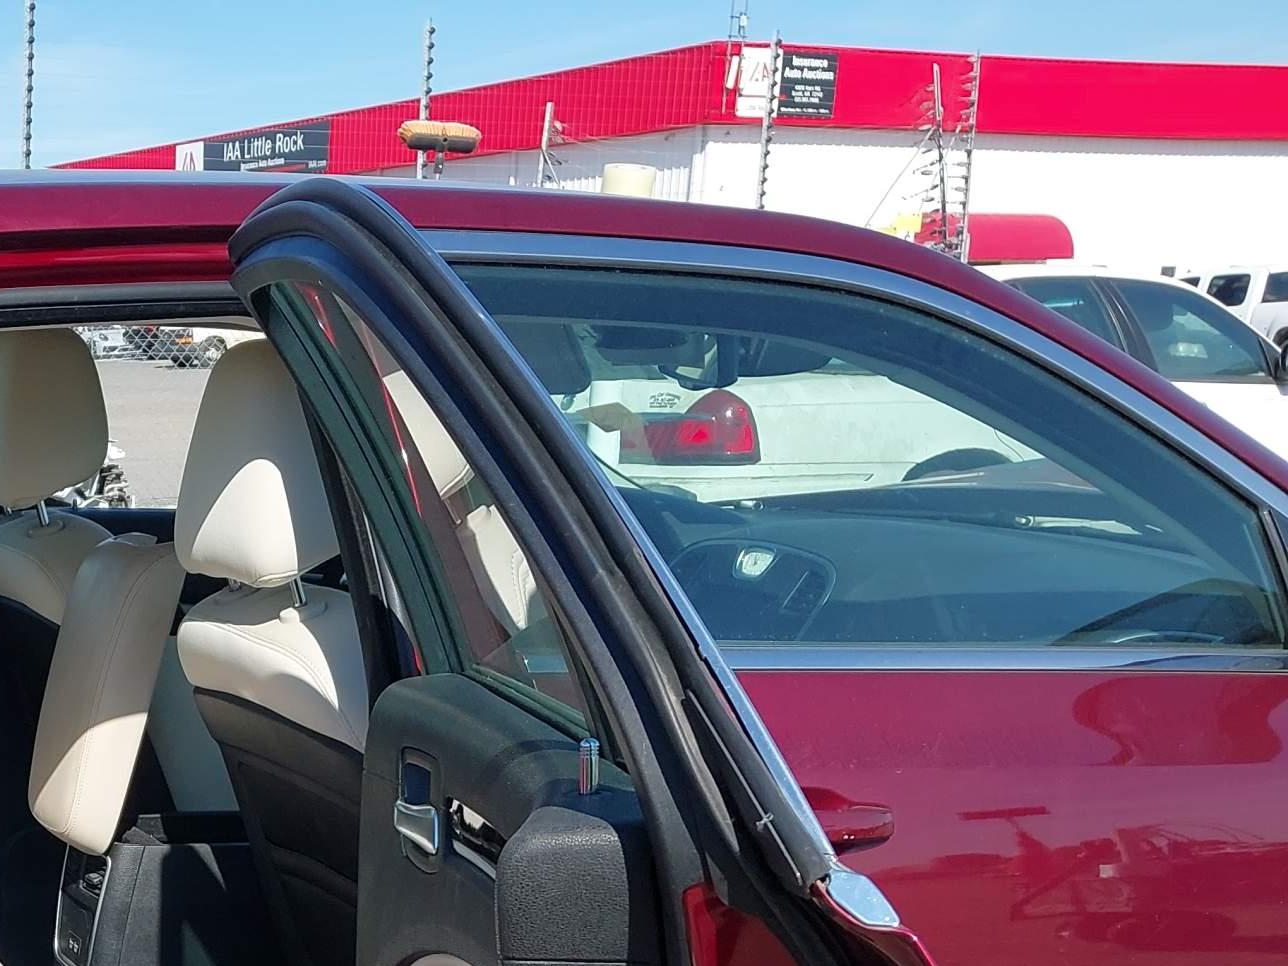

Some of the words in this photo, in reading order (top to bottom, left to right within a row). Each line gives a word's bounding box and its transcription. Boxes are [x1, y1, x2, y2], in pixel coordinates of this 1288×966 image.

[792, 55, 828, 67] Insurance
[784, 66, 802, 79] Auto
[802, 67, 834, 80] Auctions
[223, 141, 241, 162] IAA
[244, 135, 272, 159] Little
[275, 130, 304, 153] Rock
